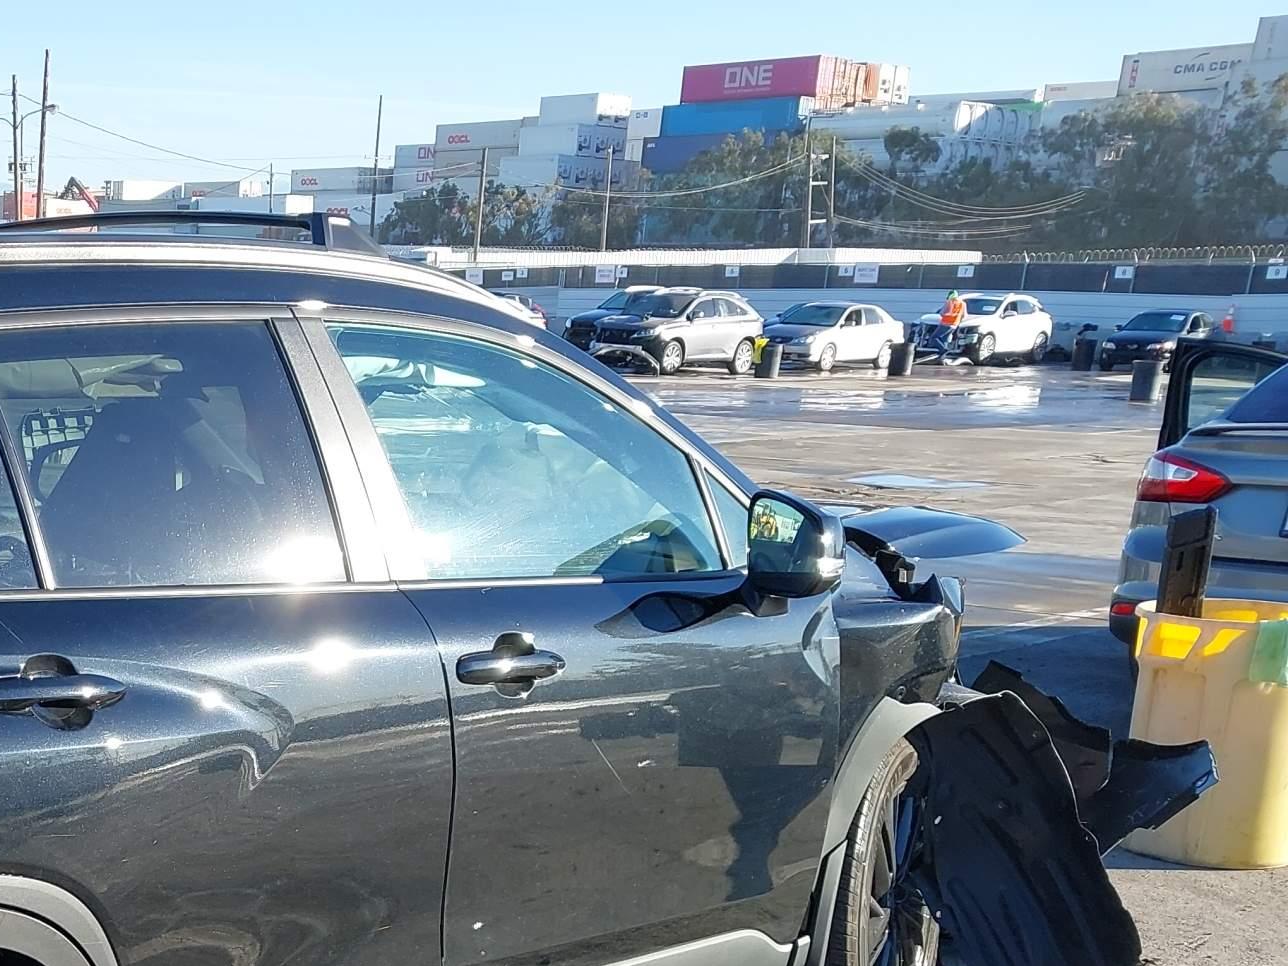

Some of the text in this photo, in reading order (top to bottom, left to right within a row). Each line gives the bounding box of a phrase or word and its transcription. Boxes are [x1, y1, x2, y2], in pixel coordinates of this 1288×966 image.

[1173, 63, 1205, 74] CMA
[724, 65, 774, 88] ONE
[447, 134, 471, 144] OOCL
[417, 147, 435, 160] ON
[415, 170, 434, 183] ON
